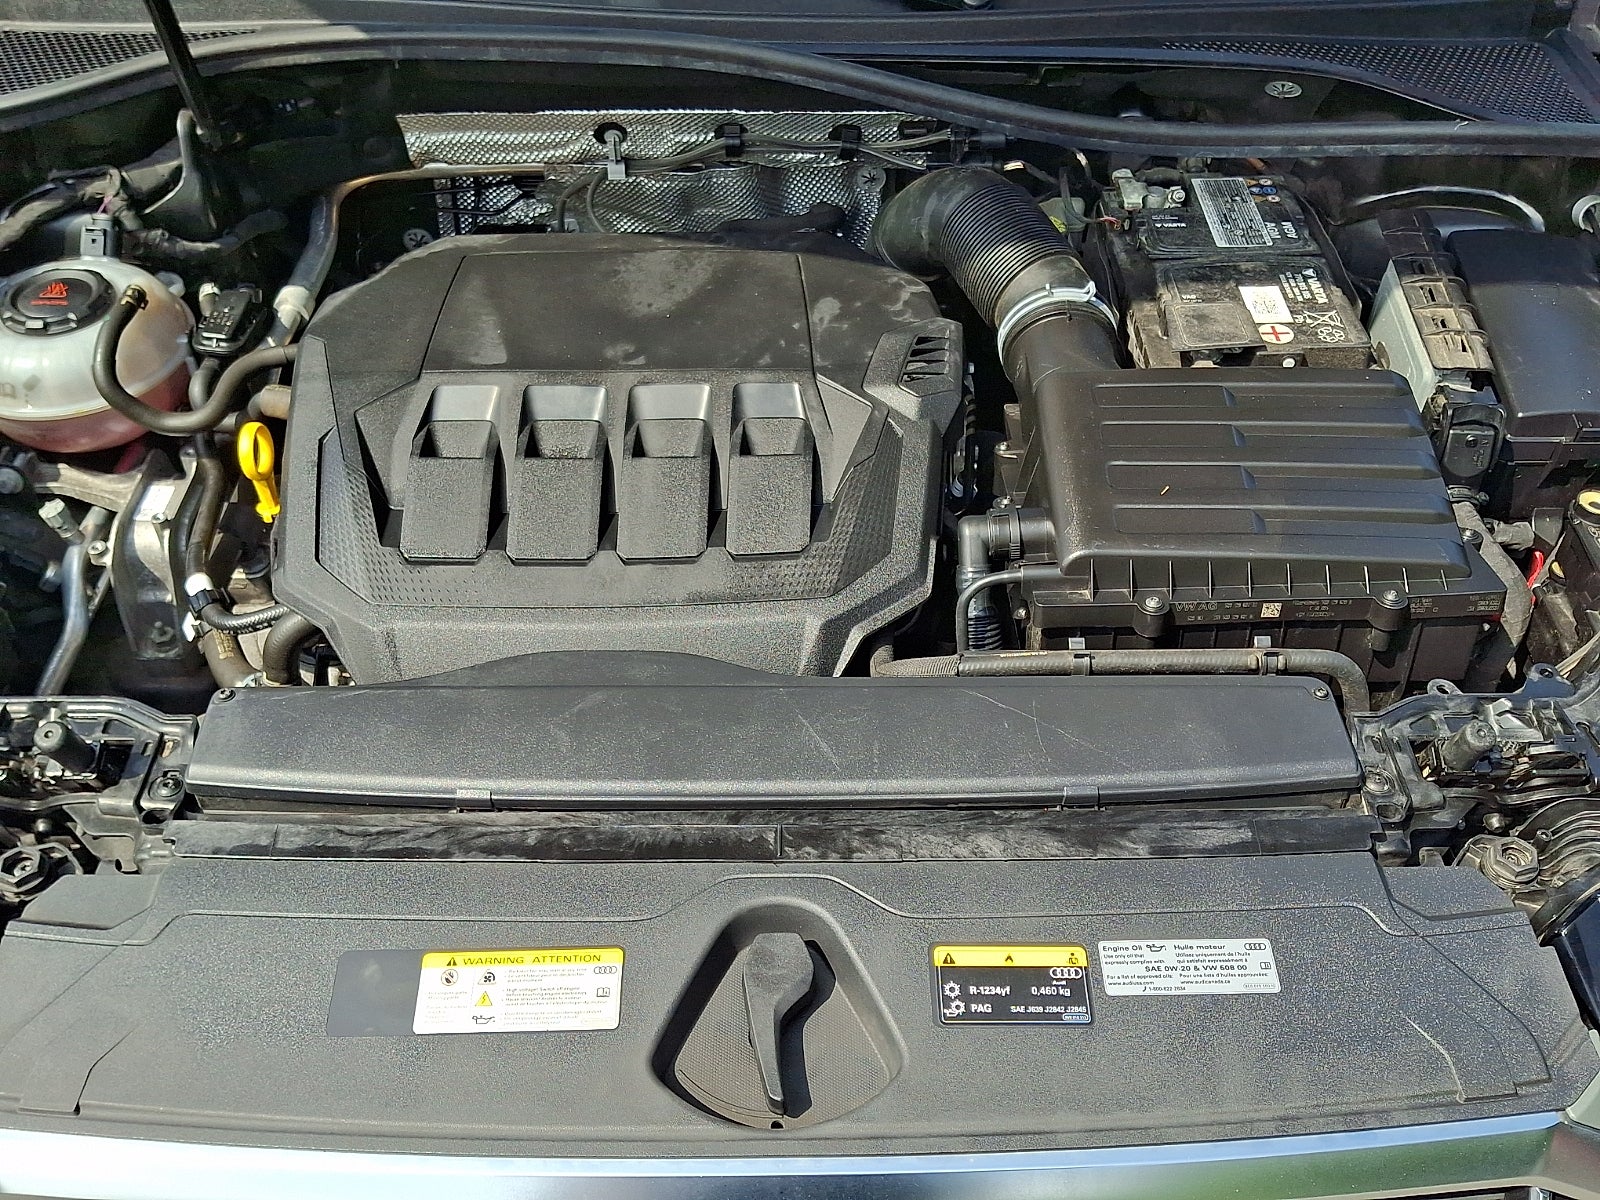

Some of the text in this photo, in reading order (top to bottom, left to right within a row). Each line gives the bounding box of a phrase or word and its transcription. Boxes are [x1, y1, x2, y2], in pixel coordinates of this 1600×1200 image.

[1265, 222, 1281, 239] AGM
[1310, 276, 1328, 304] VARTA
[1176, 602, 1196, 611] VW
[1198, 602, 1218, 610] AG
[464, 954, 601, 965] WARNING ATTENTION
[970, 986, 1071, 996] R-1234yf 0,460 kg
[971, 1004, 992, 1013] PAG
